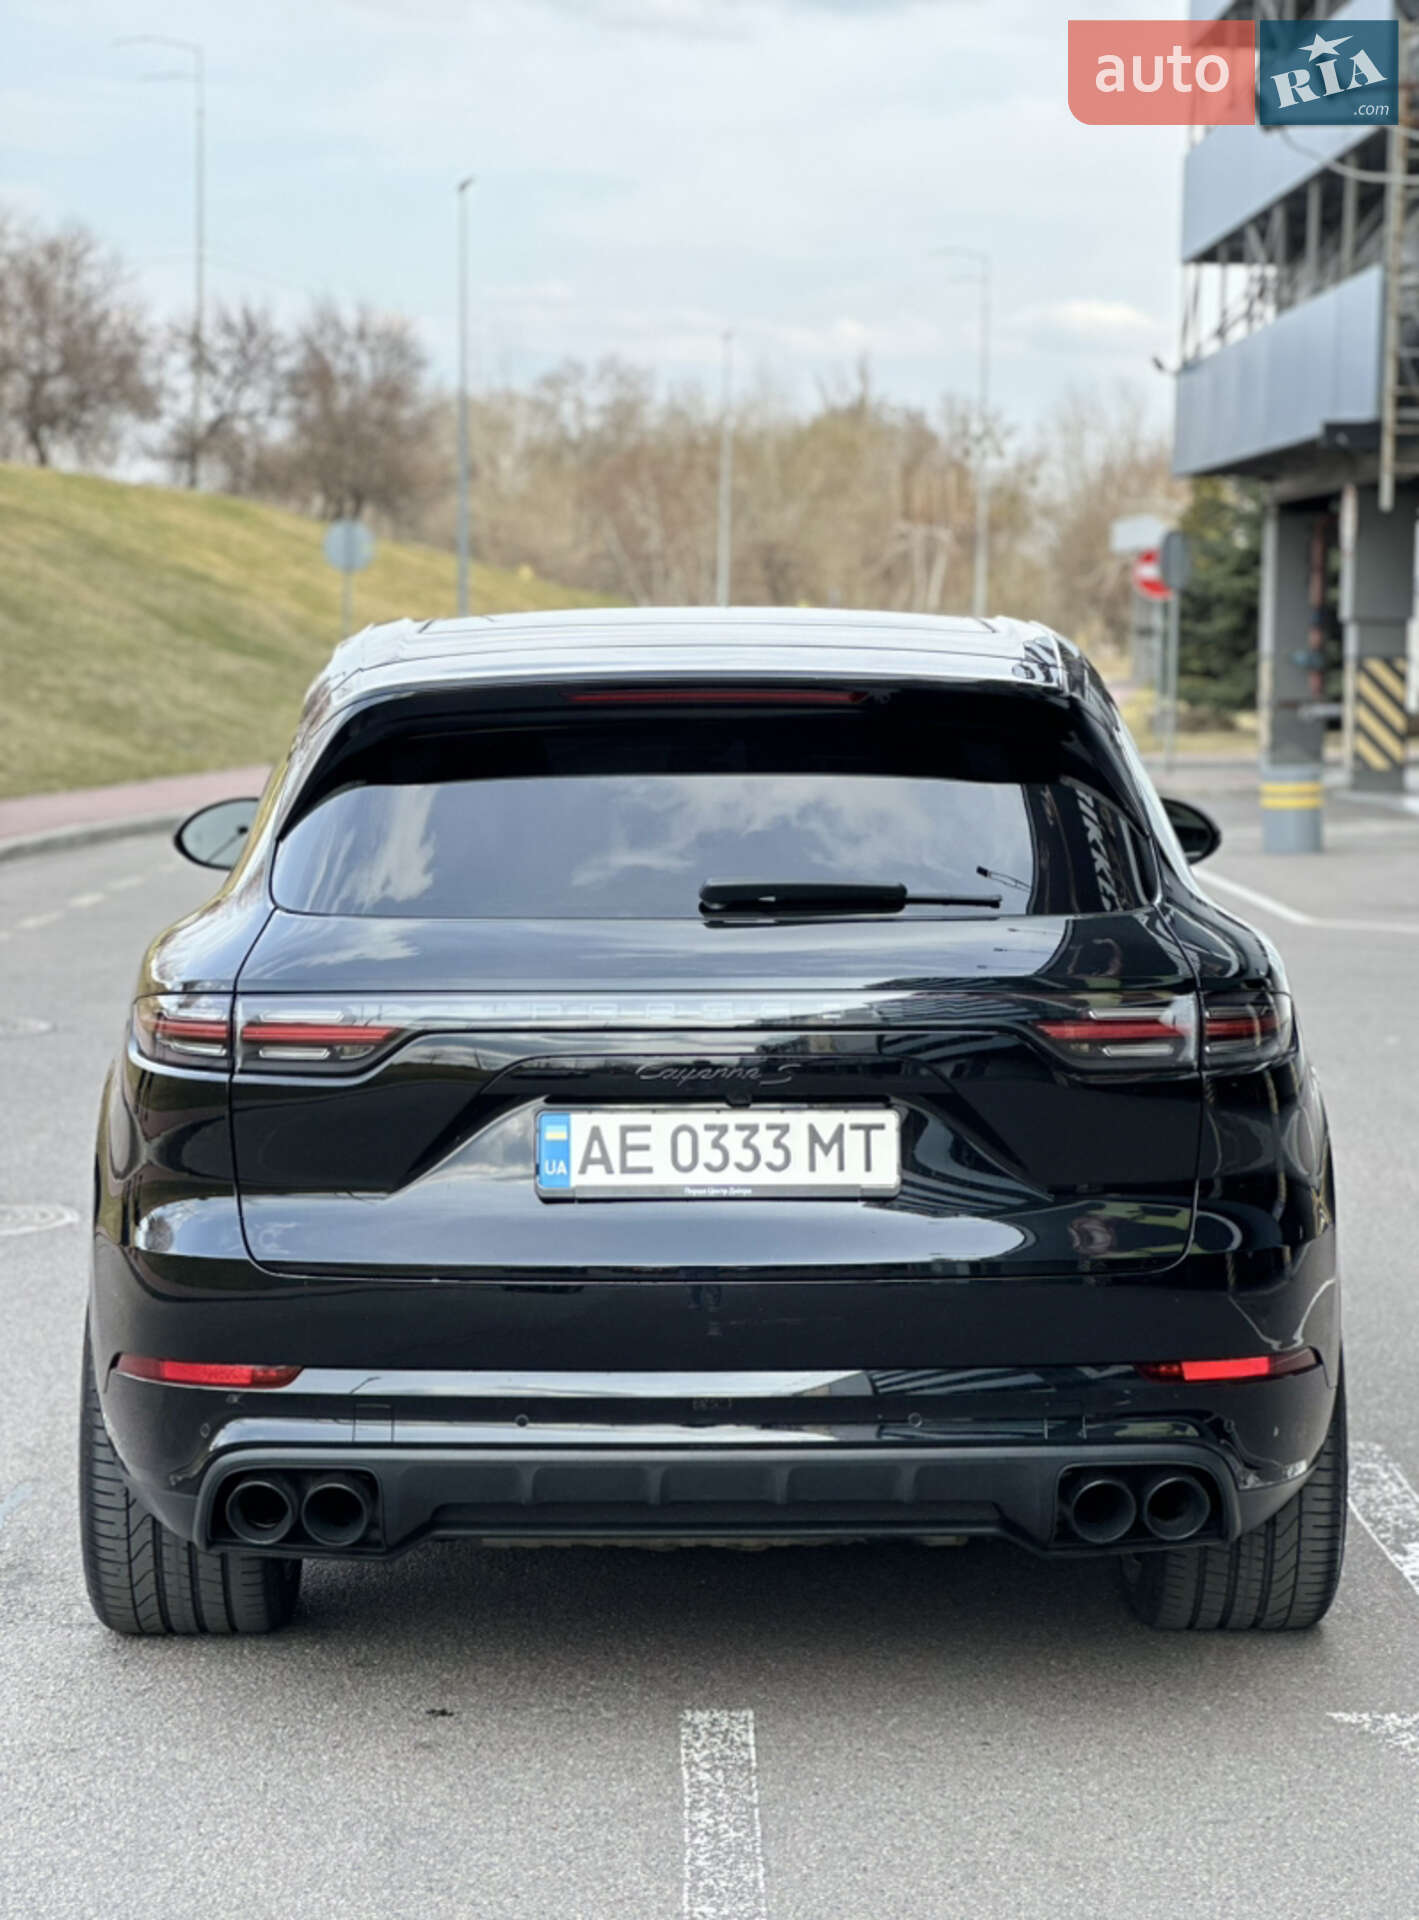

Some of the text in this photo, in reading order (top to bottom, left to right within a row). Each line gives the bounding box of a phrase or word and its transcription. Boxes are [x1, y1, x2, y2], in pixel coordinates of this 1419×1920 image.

[635, 1063, 802, 1087] Cayenne S
[578, 1123, 886, 1175] AE 0333 MT
[544, 1160, 567, 1175] UA
